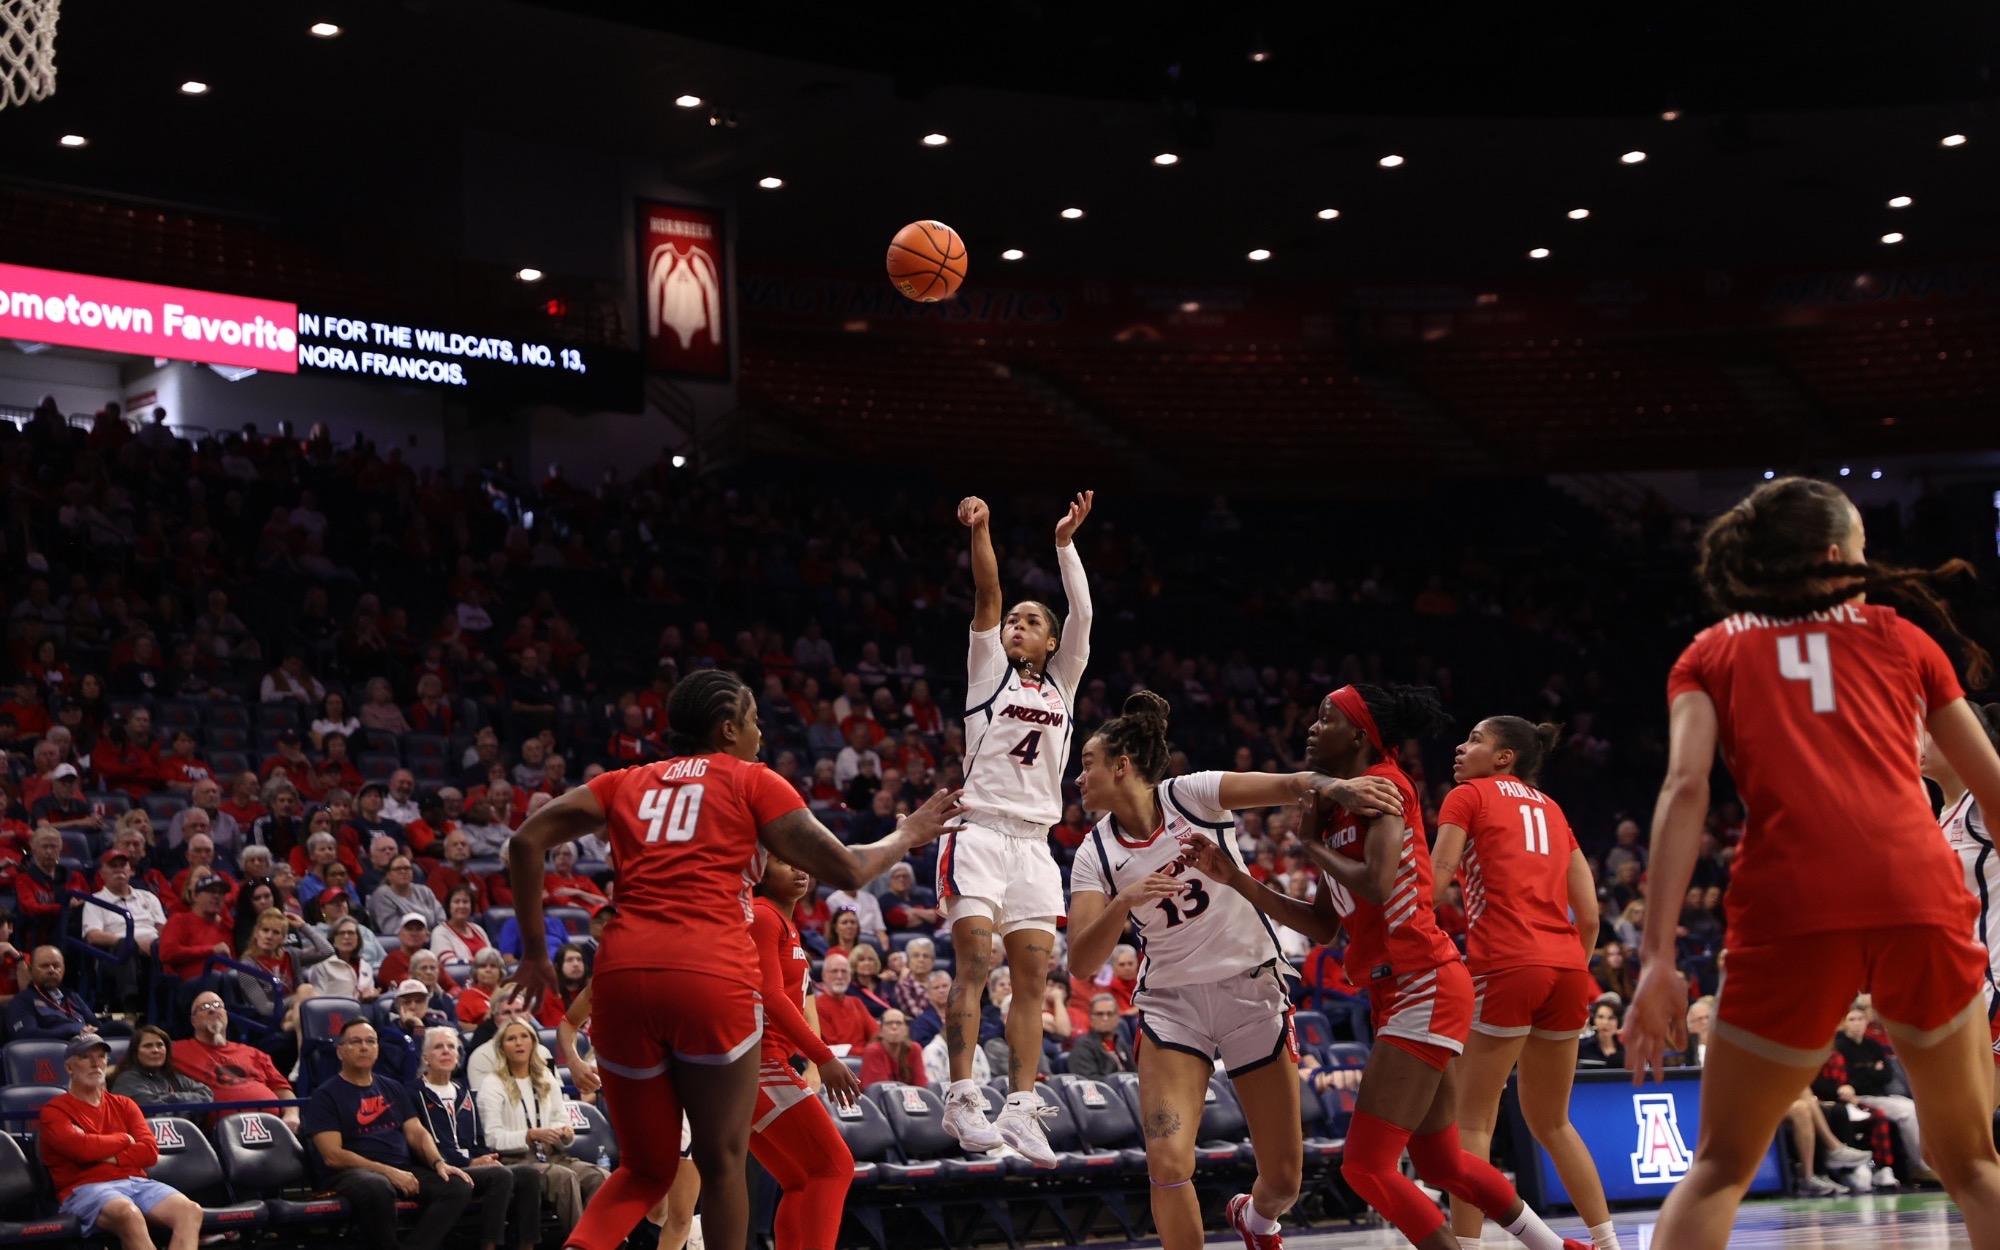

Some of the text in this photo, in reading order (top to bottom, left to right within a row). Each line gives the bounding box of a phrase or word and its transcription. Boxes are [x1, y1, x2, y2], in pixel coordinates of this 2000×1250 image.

[163, 303, 297, 352] Favorite
[298, 313, 586, 374] IN FOR THE WILDCATS, NO. 13,
[298, 344, 467, 386] NORA FRANCOIS.
[1775, 631, 1836, 714] 4
[662, 758, 710, 781] CRAIG
[1008, 729, 1042, 766] 4
[638, 783, 704, 843] 40
[1519, 804, 1550, 856] 11
[1155, 878, 1210, 929] 13
[152, 1118, 186, 1149] A
[240, 1114, 273, 1144] A
[1630, 1093, 1694, 1184] A
